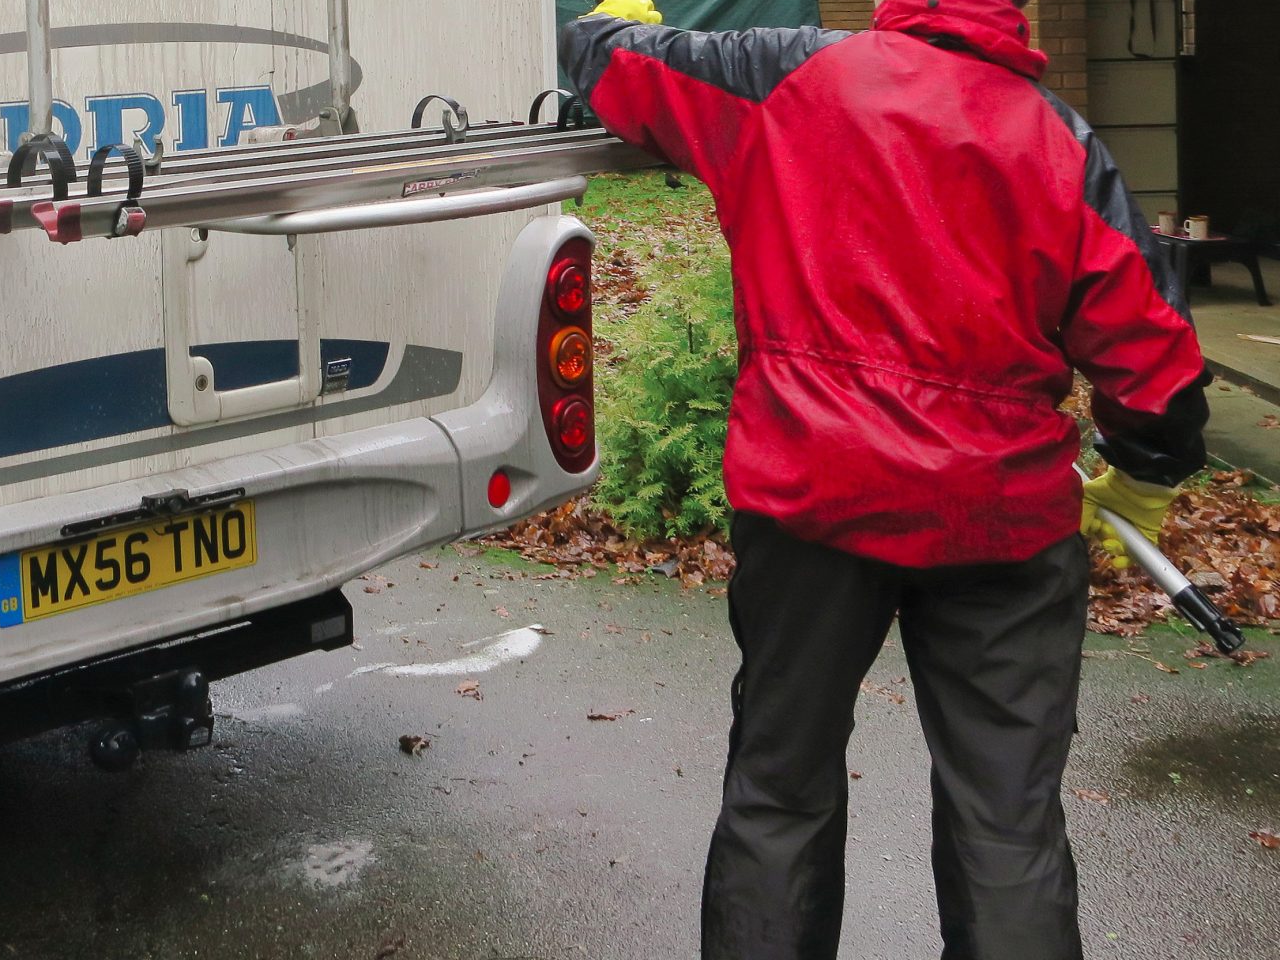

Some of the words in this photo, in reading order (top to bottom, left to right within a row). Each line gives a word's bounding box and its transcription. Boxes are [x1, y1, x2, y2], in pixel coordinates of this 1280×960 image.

[29, 532, 151, 609] MX56
[164, 509, 246, 573] TNO
[1, 596, 18, 614] GB
